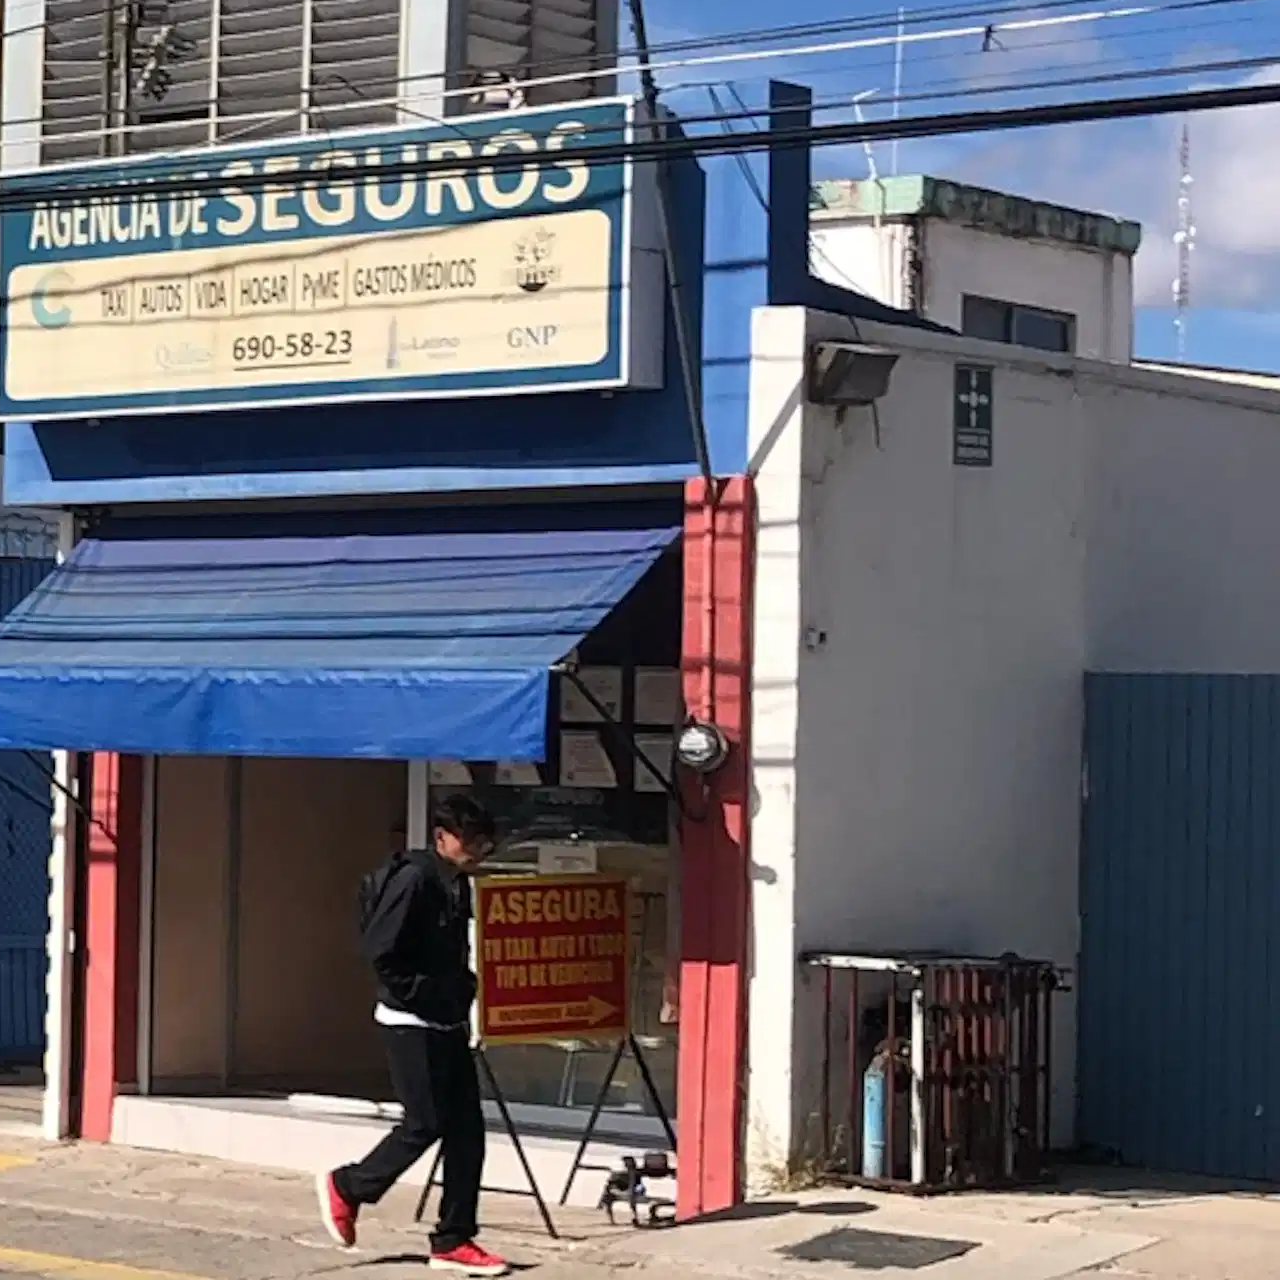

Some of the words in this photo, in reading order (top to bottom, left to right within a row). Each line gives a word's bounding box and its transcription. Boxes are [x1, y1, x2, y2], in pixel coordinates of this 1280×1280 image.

[28, 177, 161, 251] AGENCIA
[168, 171, 210, 237] DE
[216, 121, 590, 237] SEGUROS
[99, 289, 127, 317] TAXI
[140, 283, 183, 315] AUTOS
[194, 279, 228, 310] VIDA
[240, 274, 289, 306] HOGAR
[352, 263, 408, 297] GASTOS
[411, 252, 477, 294] MÉDICOS
[232, 330, 353, 361] 690-58-23
[506, 324, 558, 349] GNP
[487, 888, 621, 925] ASEGURA
[495, 964, 527, 990] TIPO
